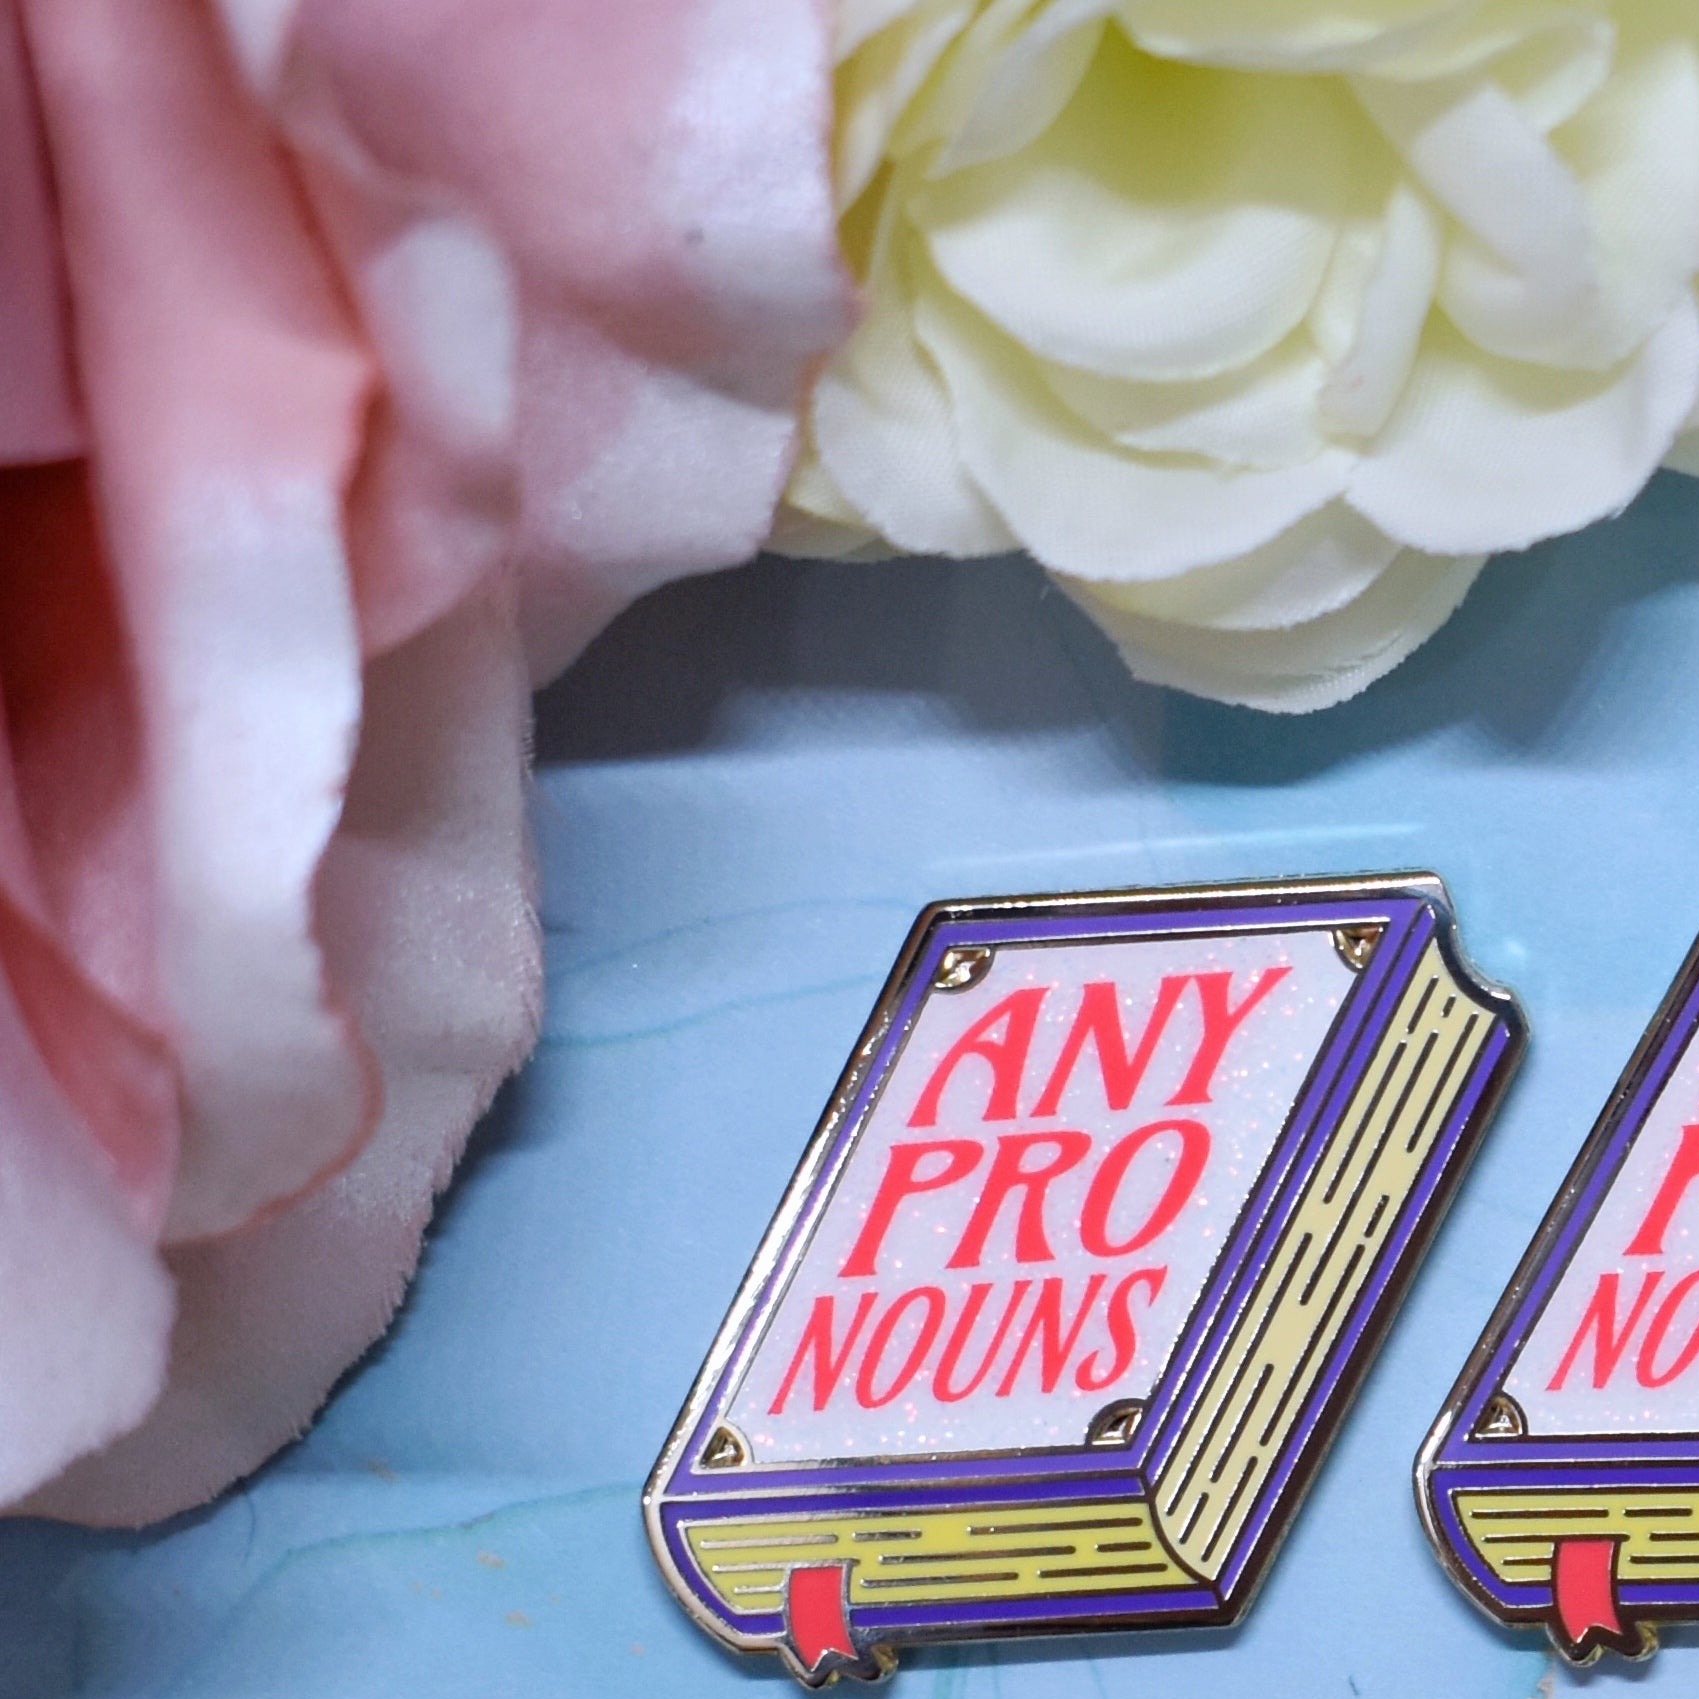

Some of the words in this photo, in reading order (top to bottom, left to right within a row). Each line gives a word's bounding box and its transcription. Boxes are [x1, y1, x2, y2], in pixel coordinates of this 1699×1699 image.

[907, 965, 1292, 1130] ANY
[838, 1117, 1213, 1280] PRO
[769, 1264, 1169, 1416] NOUNS
